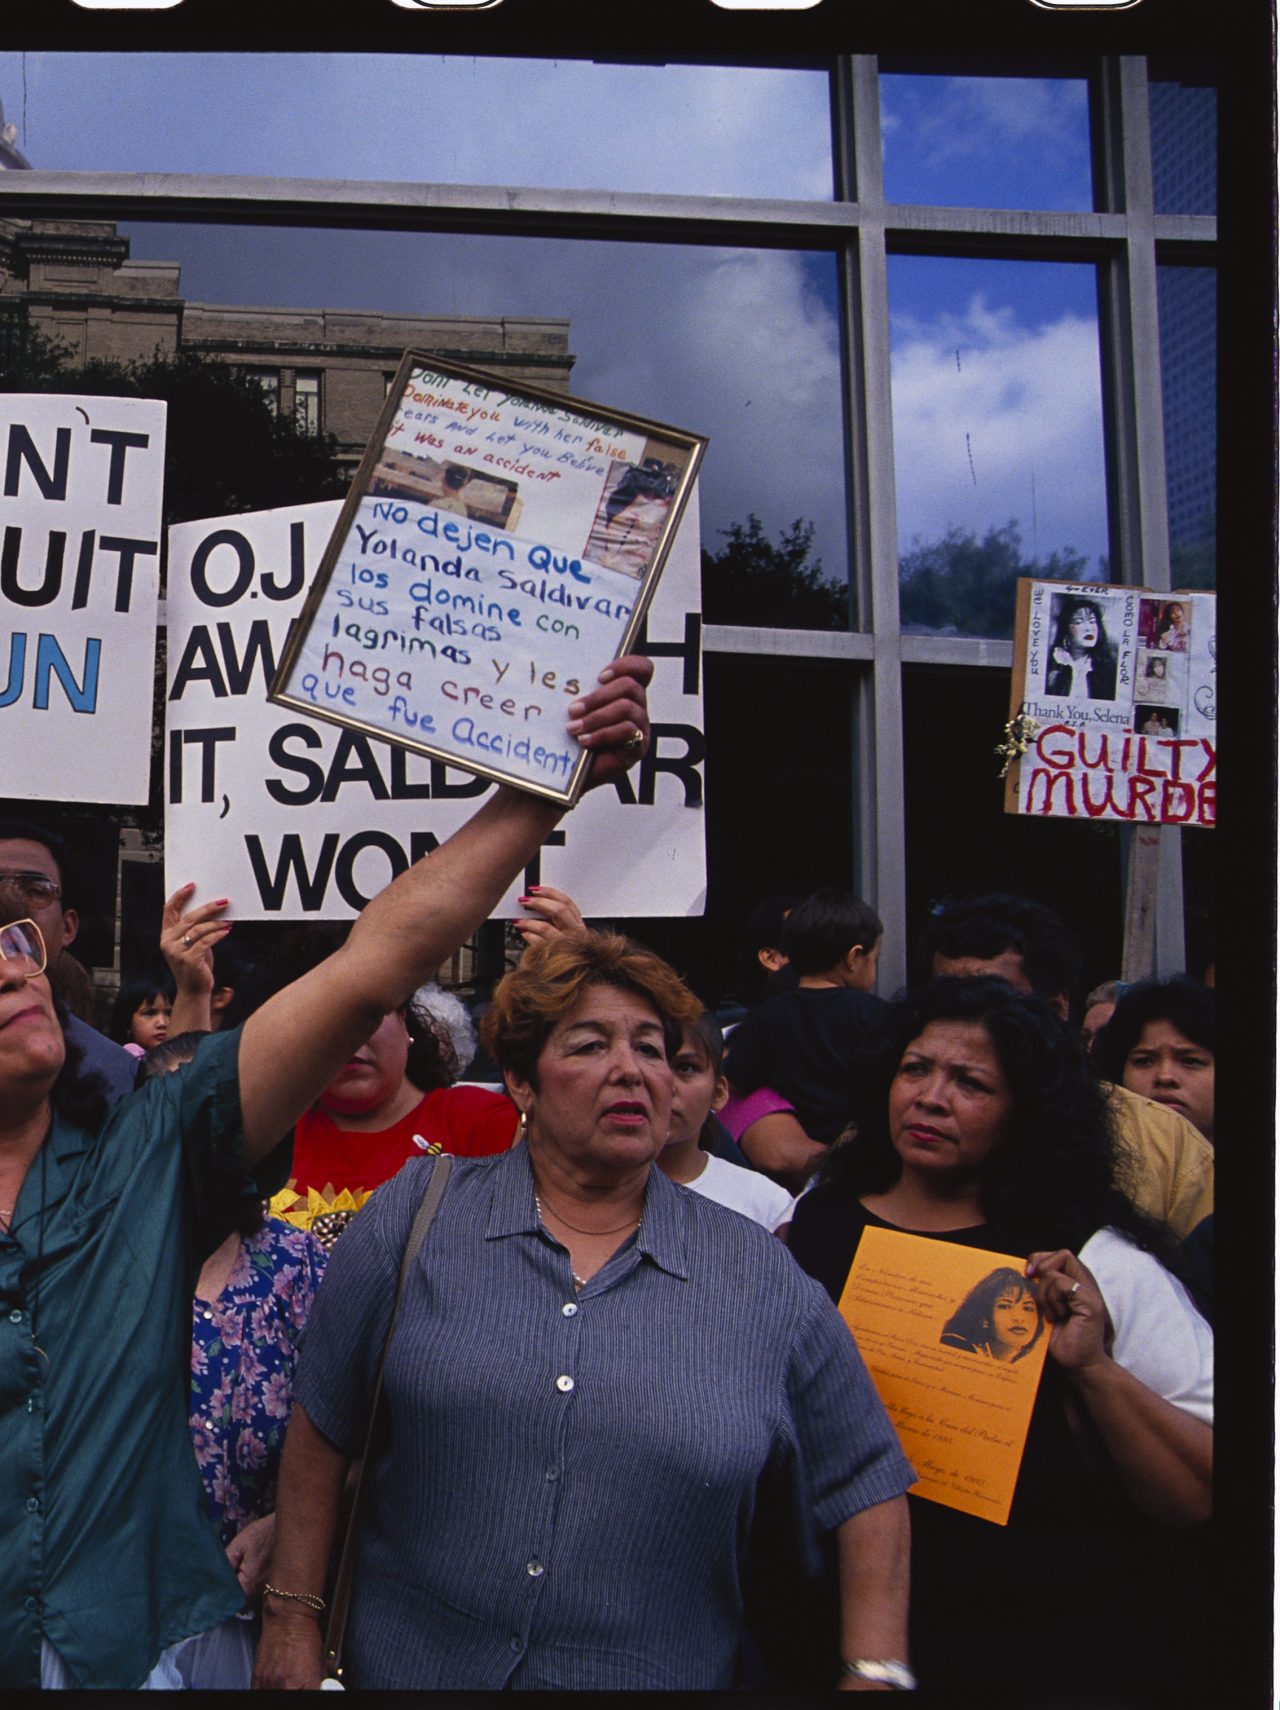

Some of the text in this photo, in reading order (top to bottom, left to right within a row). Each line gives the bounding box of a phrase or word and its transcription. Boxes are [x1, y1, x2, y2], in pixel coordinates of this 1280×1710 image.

[399, 407, 440, 424] ears
[554, 427, 583, 444] her
[586, 437, 627, 460] false
[355, 524, 633, 621] Yolanda Saldivar
[416, 511, 516, 561] dejen
[526, 544, 593, 585] Que
[351, 563, 581, 641] los domine con
[412, 605, 503, 642] falsas
[321, 643, 543, 722] haga creer
[332, 613, 472, 666] lagrimas
[530, 661, 581, 697] les
[301, 672, 358, 708] que
[388, 695, 437, 735] fue
[1024, 701, 1064, 720] Thank
[1093, 707, 1131, 726] Selena
[169, 726, 236, 819] IT,
